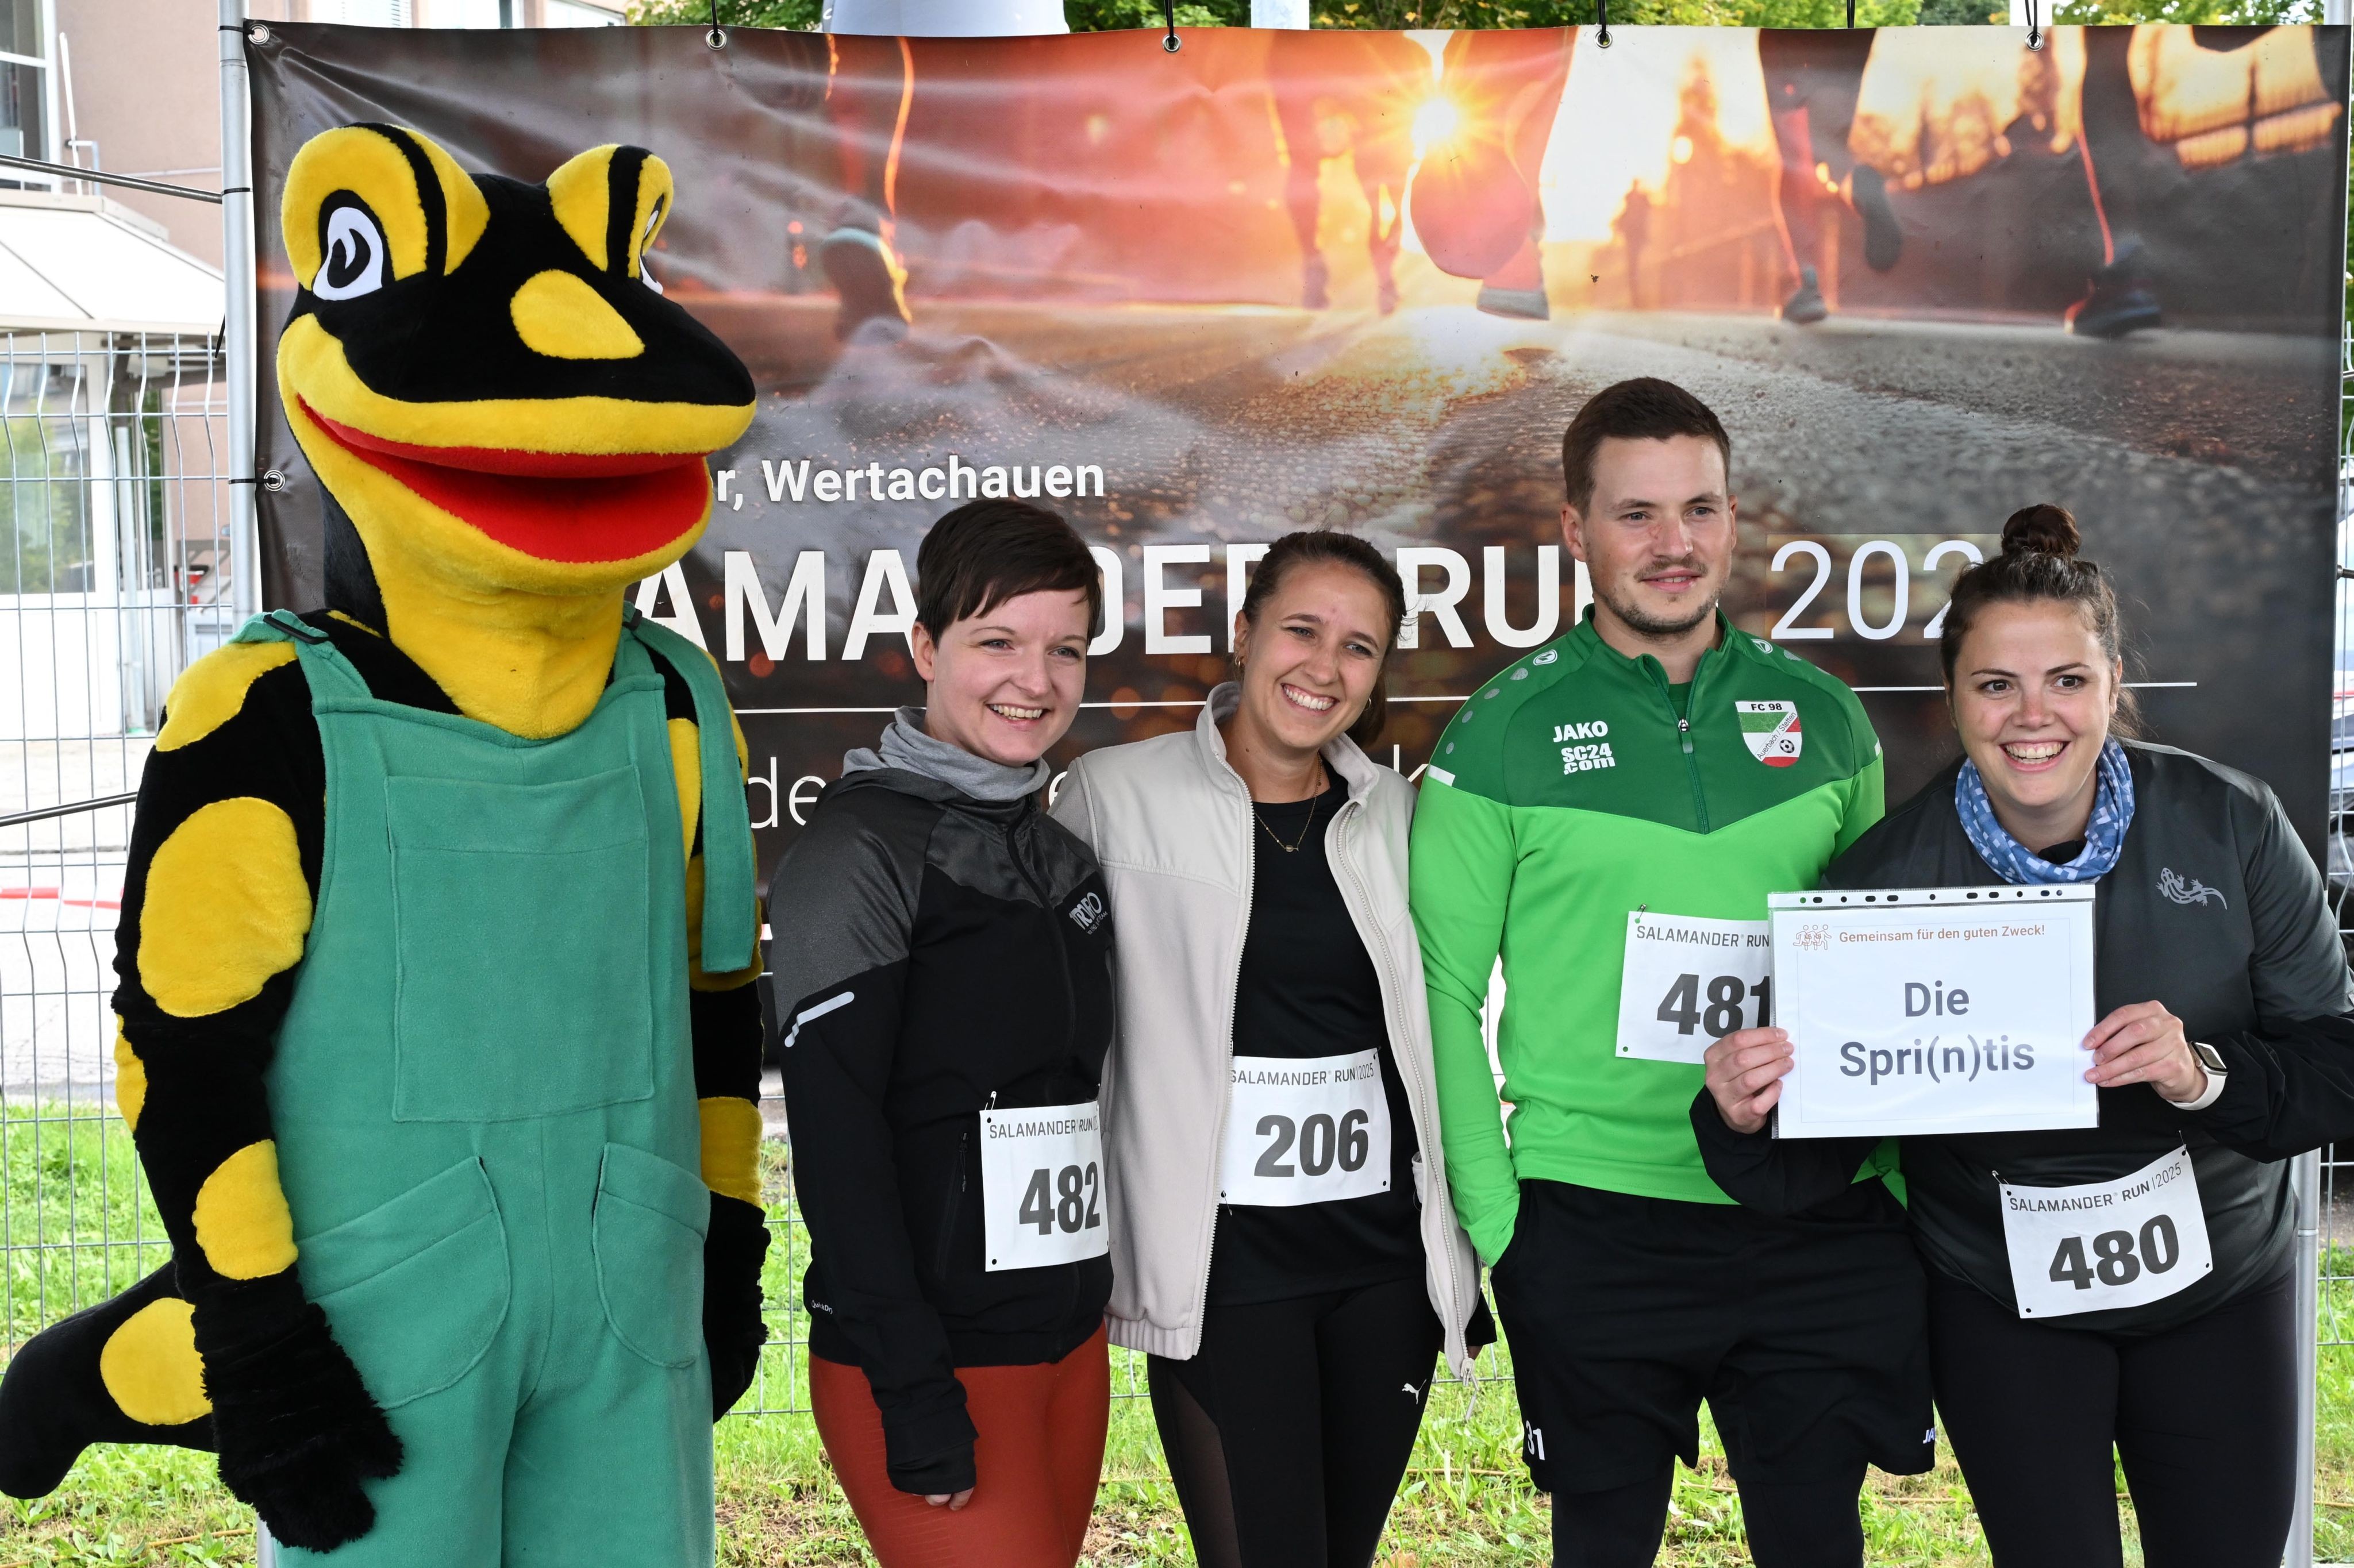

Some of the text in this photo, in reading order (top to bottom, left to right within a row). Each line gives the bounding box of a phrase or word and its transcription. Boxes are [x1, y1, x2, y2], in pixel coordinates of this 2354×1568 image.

[762, 455, 1104, 502] Wertachauen
[1397, 545, 1595, 649] RU
[1771, 540, 1984, 639] 202
[1553, 721, 1608, 742] JAKO
[1757, 733, 1779, 759] Auerbach
[1779, 712, 1797, 731] Stetten
[1561, 743, 1612, 762] SC24
[1563, 757, 1616, 775] .com
[1747, 934, 1770, 947] RUN
[1839, 924, 2045, 942] Gemeinsam für den guten Zweck!
[1656, 973, 1770, 1038] 481
[1905, 980, 1970, 1017] Die
[1334, 1070, 1356, 1082] RUN
[1840, 1034, 2034, 1085] Spri(n)tis
[1079, 1118, 1093, 1132] RUN
[1254, 1109, 1368, 1177] 206
[1019, 1161, 1100, 1235] 482
[2122, 1181, 2150, 1201] RUN
[2049, 1214, 2179, 1290] 480
[1526, 1420, 1545, 1461] 31
[1923, 1428, 1935, 1444] JA
